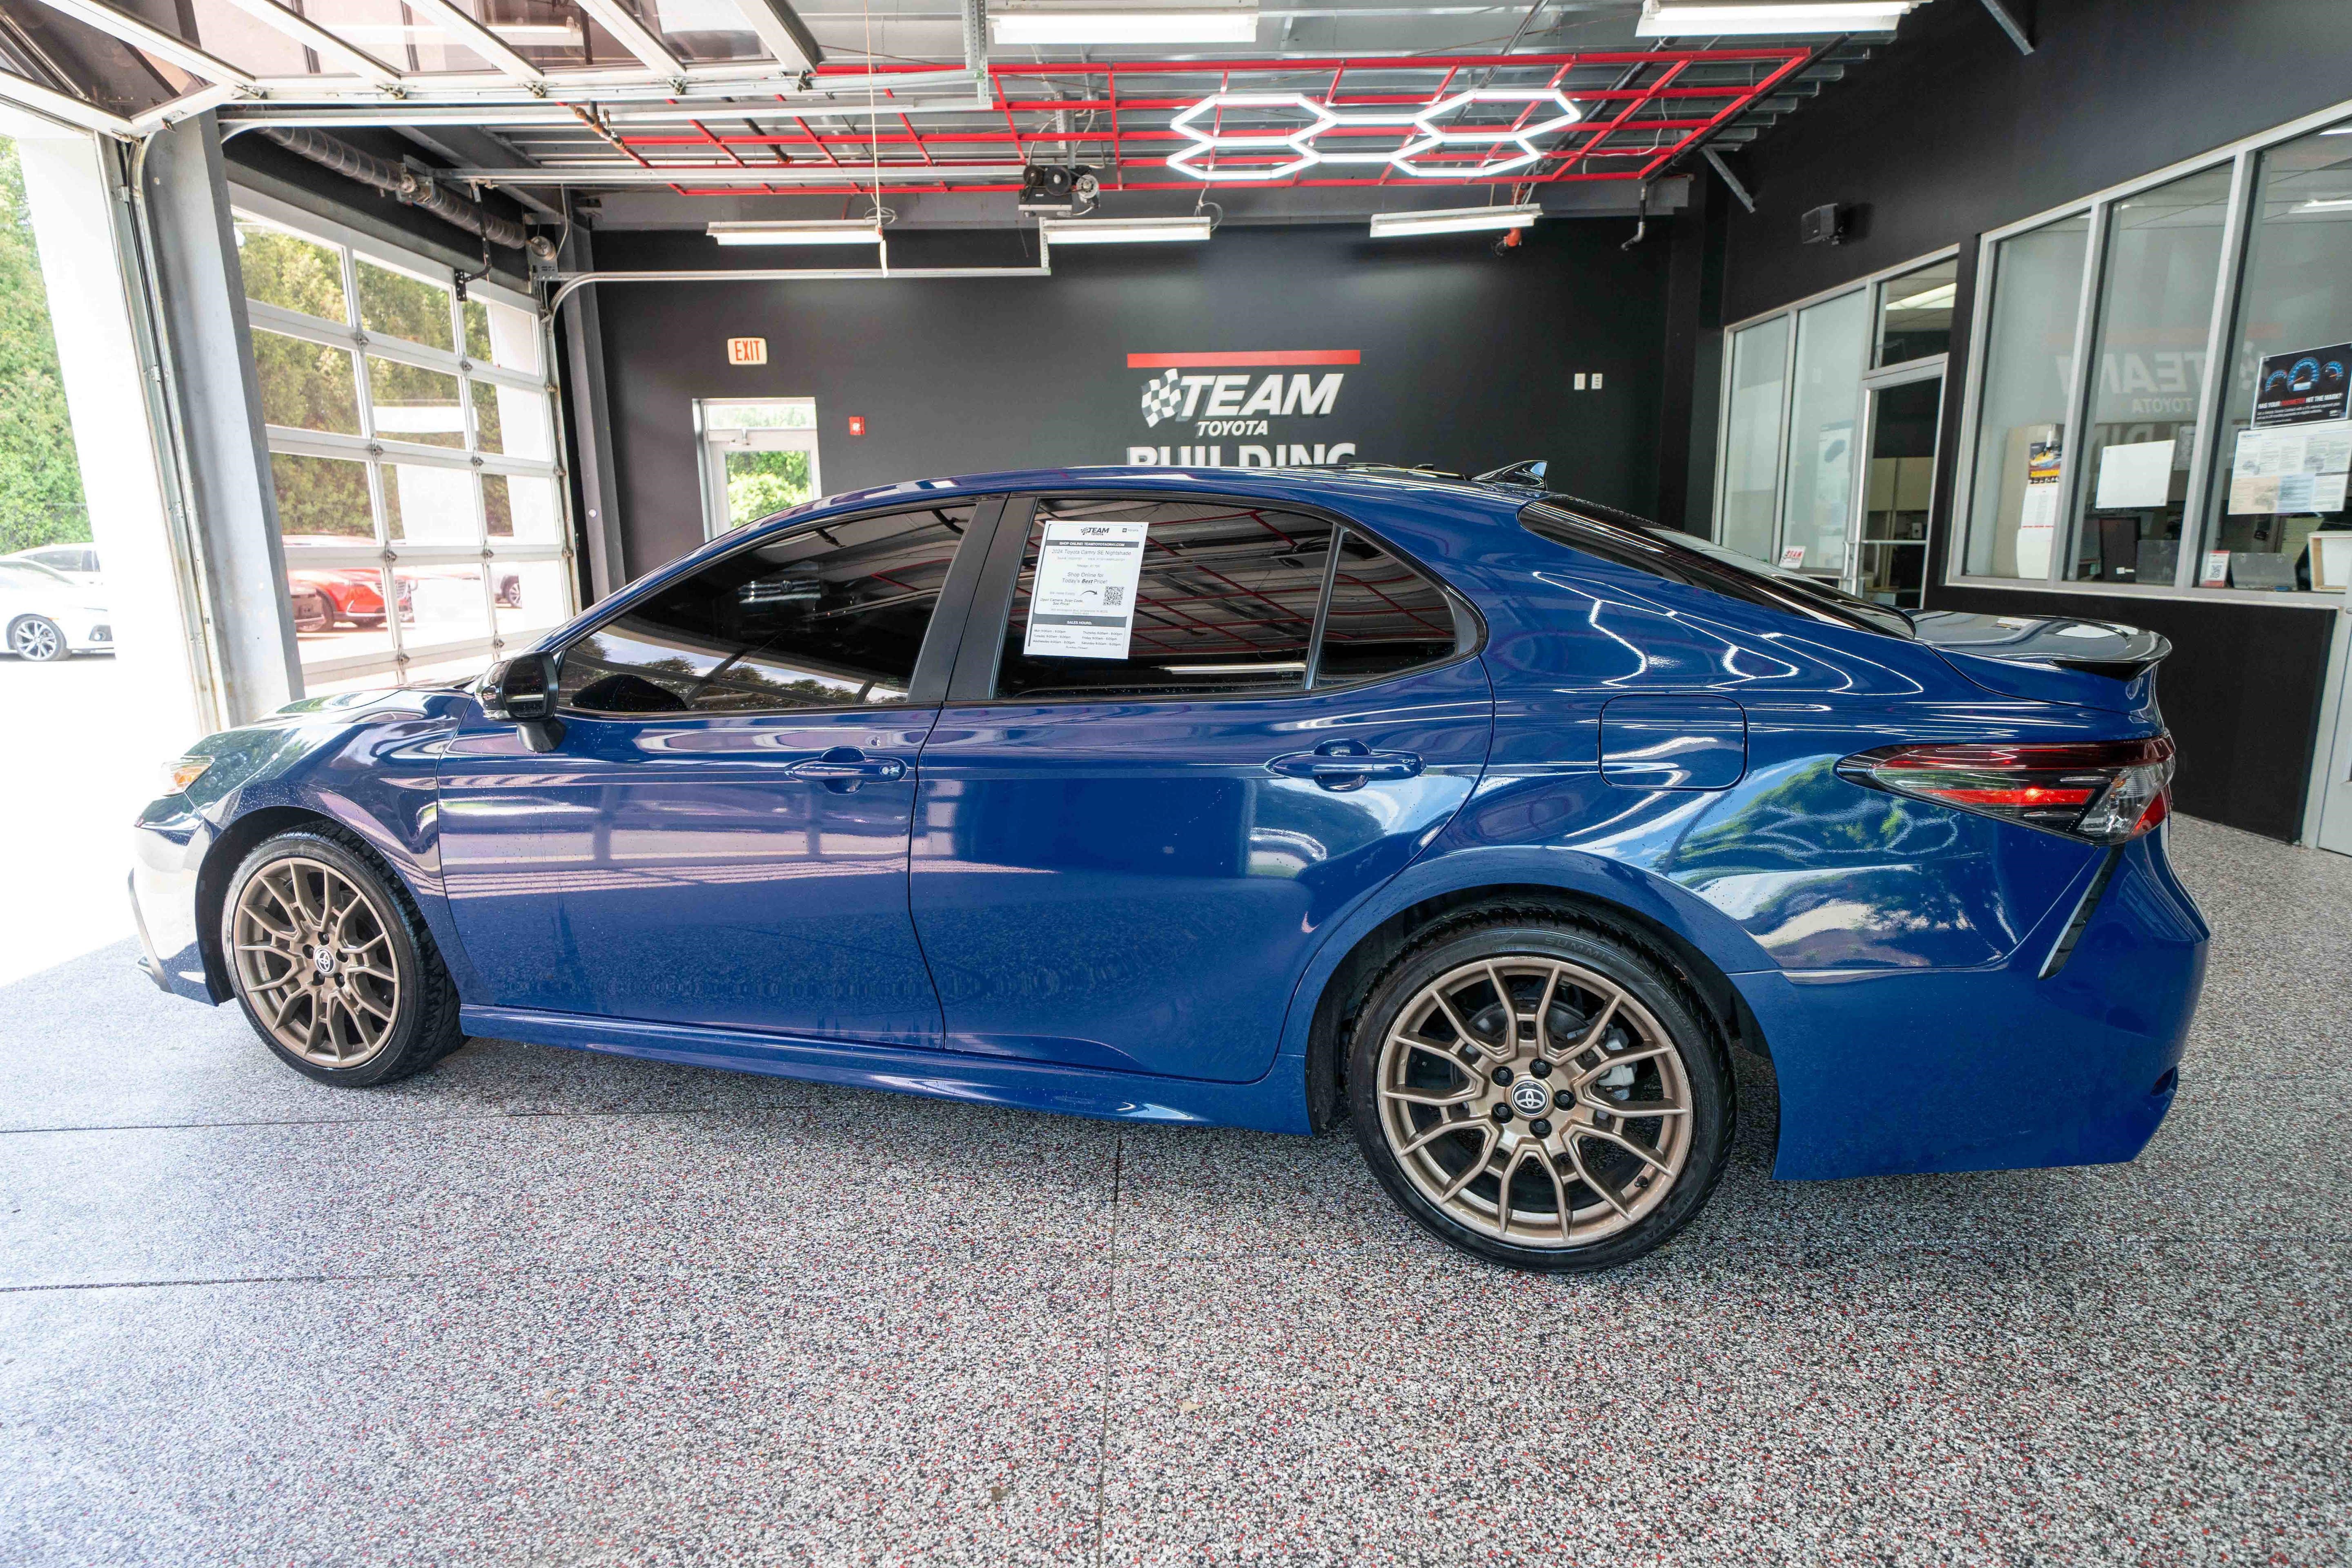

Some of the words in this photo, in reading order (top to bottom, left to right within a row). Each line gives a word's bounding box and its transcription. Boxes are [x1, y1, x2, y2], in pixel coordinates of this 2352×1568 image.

[735, 340, 760, 361] EXIT
[1177, 373, 1344, 419] TEAM
[1196, 420, 1268, 437] TOYOTA
[1544, 936, 1618, 966] SUMMIT
